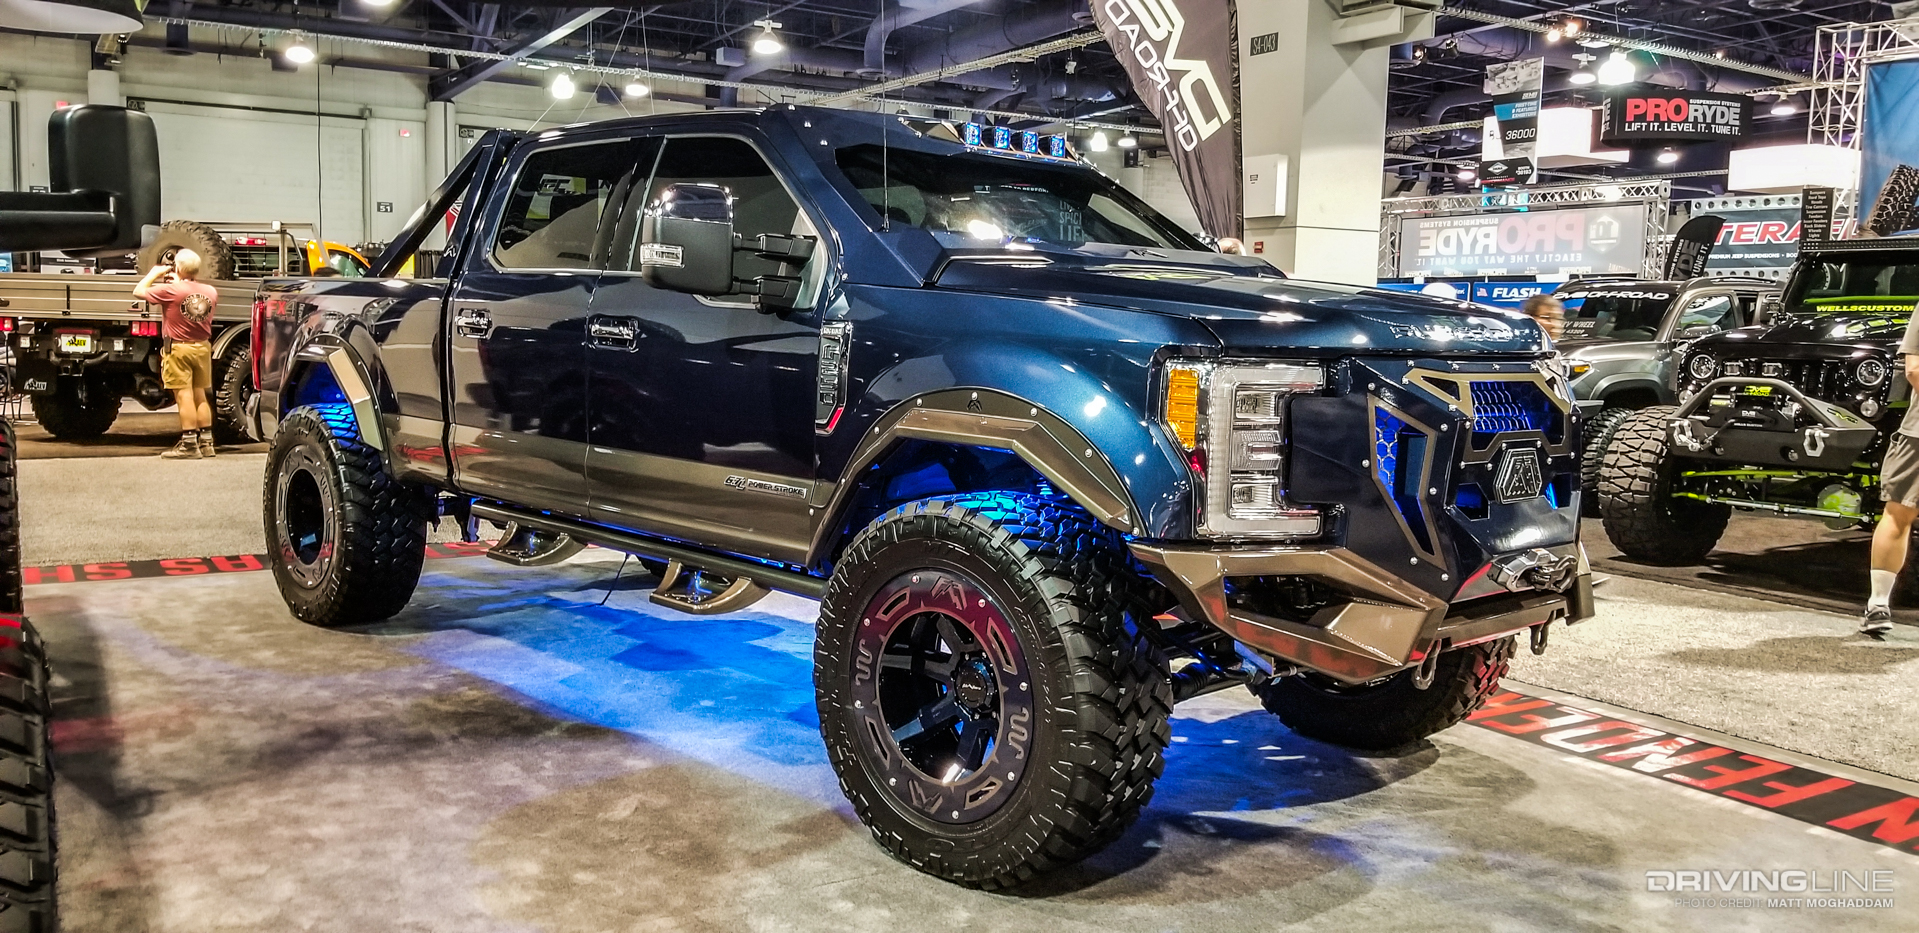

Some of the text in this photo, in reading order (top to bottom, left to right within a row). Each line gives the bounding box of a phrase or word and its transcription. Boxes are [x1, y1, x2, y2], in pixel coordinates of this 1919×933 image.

[1505, 128, 1536, 140] 36000
[1625, 122, 1741, 136] LIFT IT. LEVEL IT. TUNE IT.
[1691, 254, 1705, 277] TUNE
[1492, 287, 1542, 298] FLASH
[1588, 291, 1670, 301] OFFROAD
[266, 299, 296, 319] FX4
